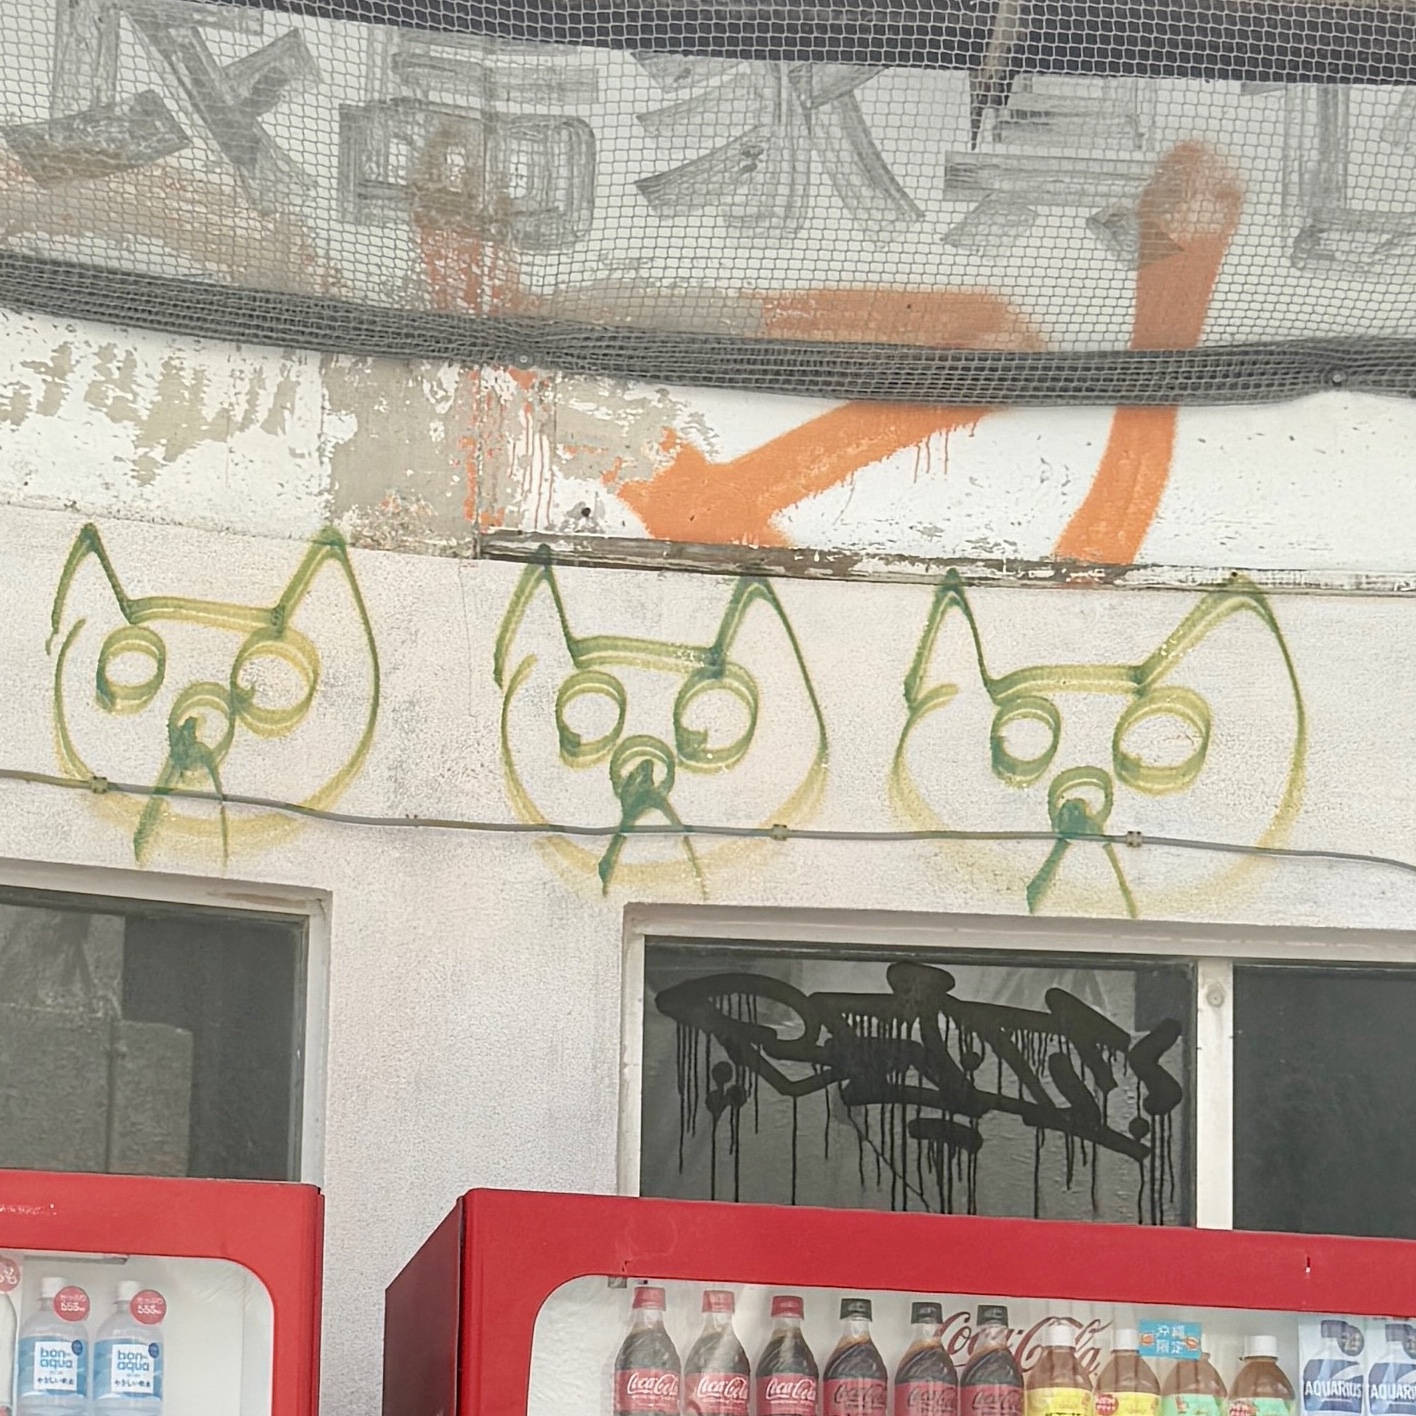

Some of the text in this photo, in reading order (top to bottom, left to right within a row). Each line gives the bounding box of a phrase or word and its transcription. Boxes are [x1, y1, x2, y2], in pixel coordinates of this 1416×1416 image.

[1156, 1325, 1185, 1337] 沖縄
[1156, 1340, 1184, 1353] 限定
[1305, 1379, 1361, 1396] AQUARIUS
